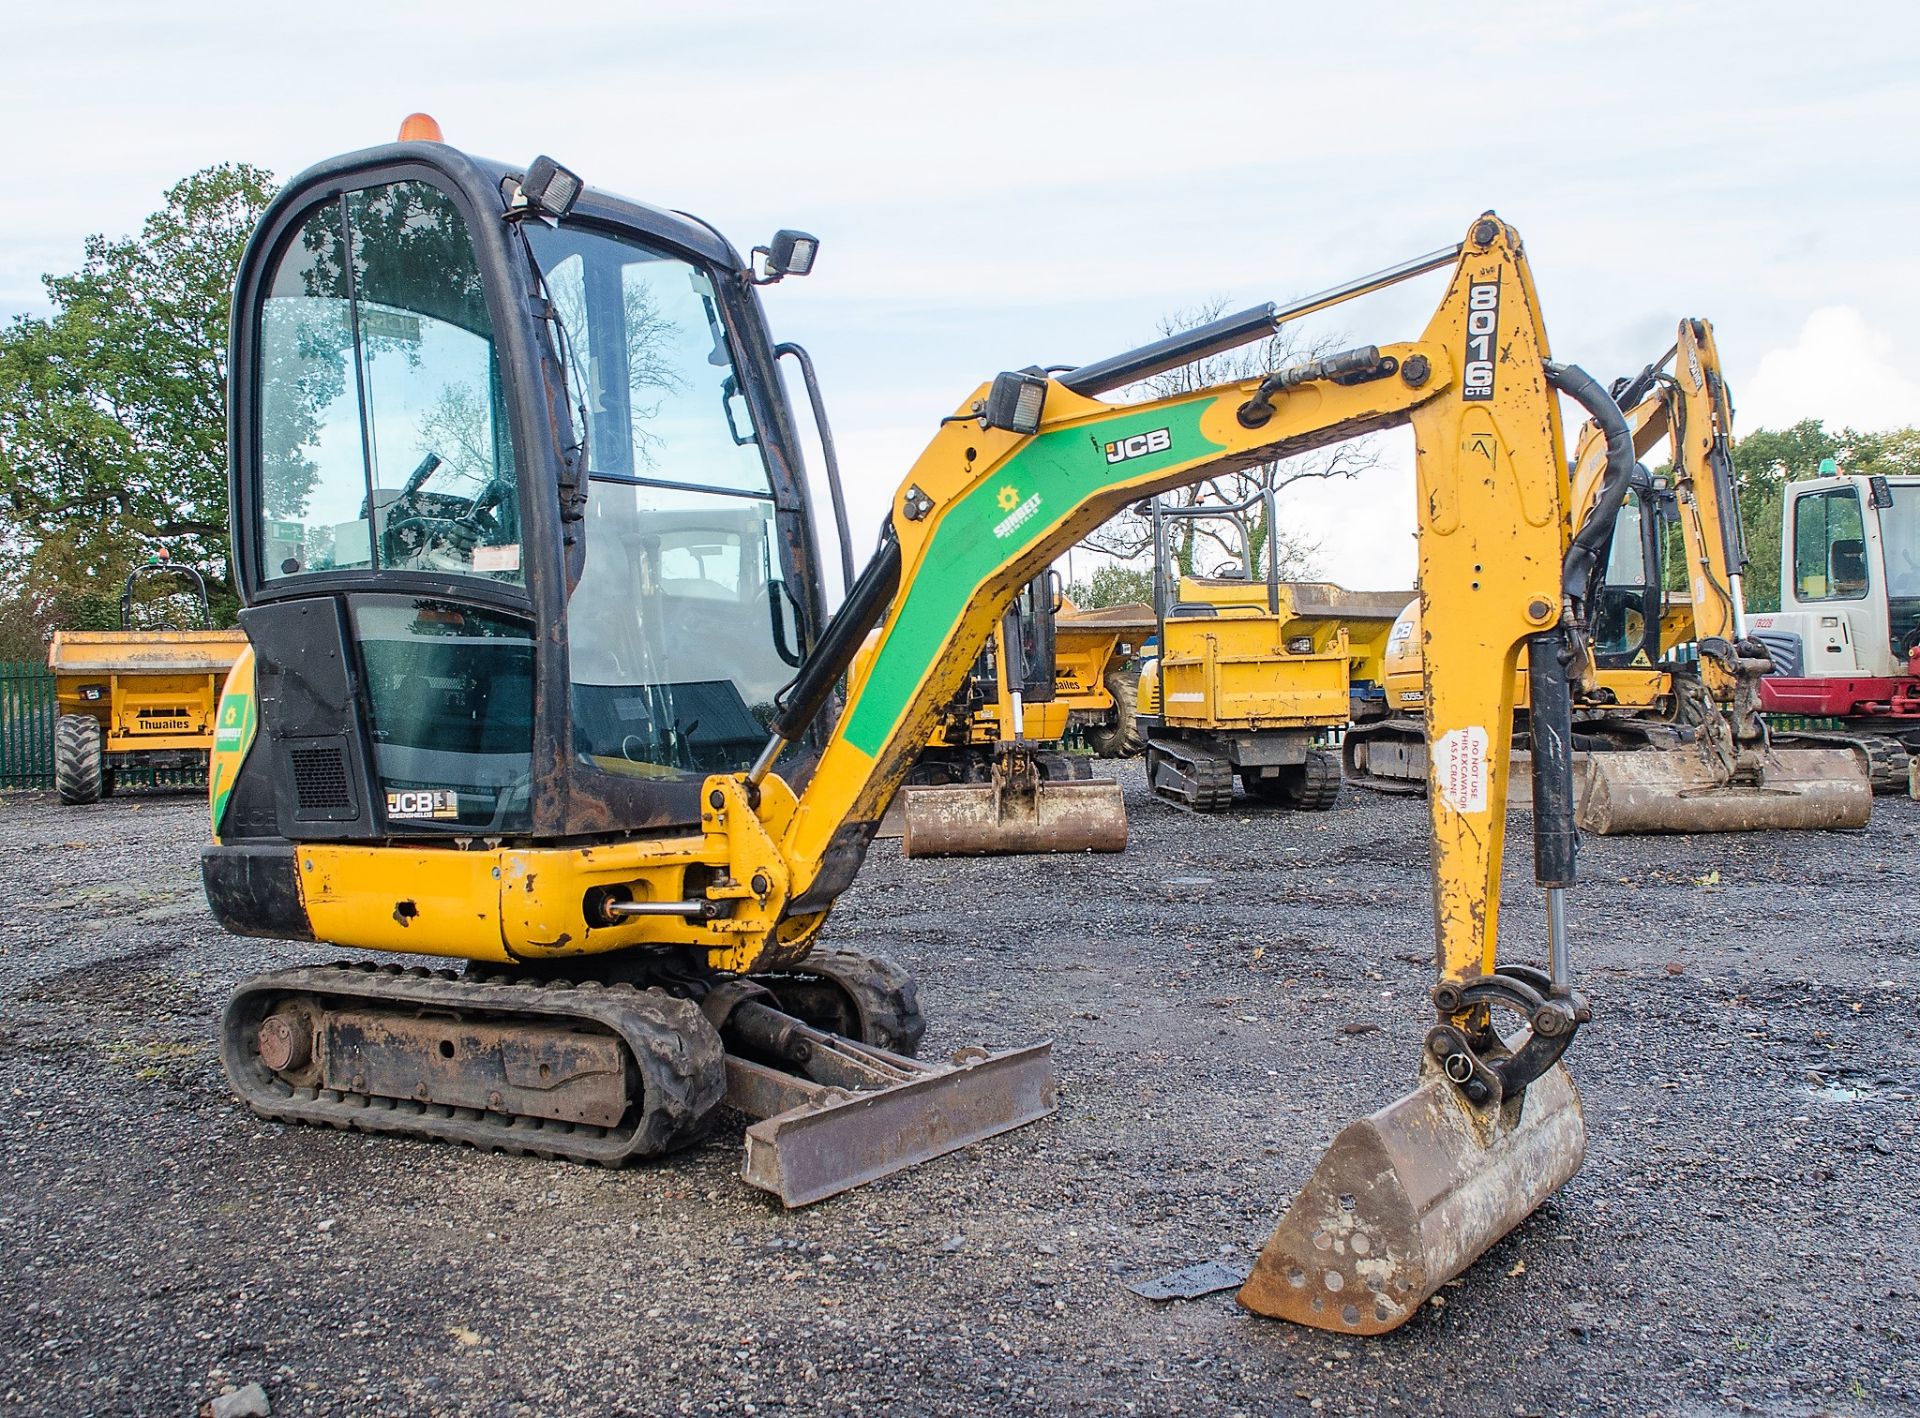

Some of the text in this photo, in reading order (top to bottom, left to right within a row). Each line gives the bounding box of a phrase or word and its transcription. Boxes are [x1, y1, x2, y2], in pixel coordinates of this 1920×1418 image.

[1465, 285, 1497, 387] 8016
[1465, 386, 1492, 396] CTS
[1105, 429, 1171, 463] JCB
[1055, 681, 1080, 690] aites
[139, 720, 190, 730] Thwaites
[1450, 741, 1458, 753] AS
[1450, 764, 1458, 797] CRANE
[1460, 729, 1469, 809] THIS EXCAVATOR
[1471, 740, 1479, 799] DO NOT USE
[387, 793, 433, 813] JCB
